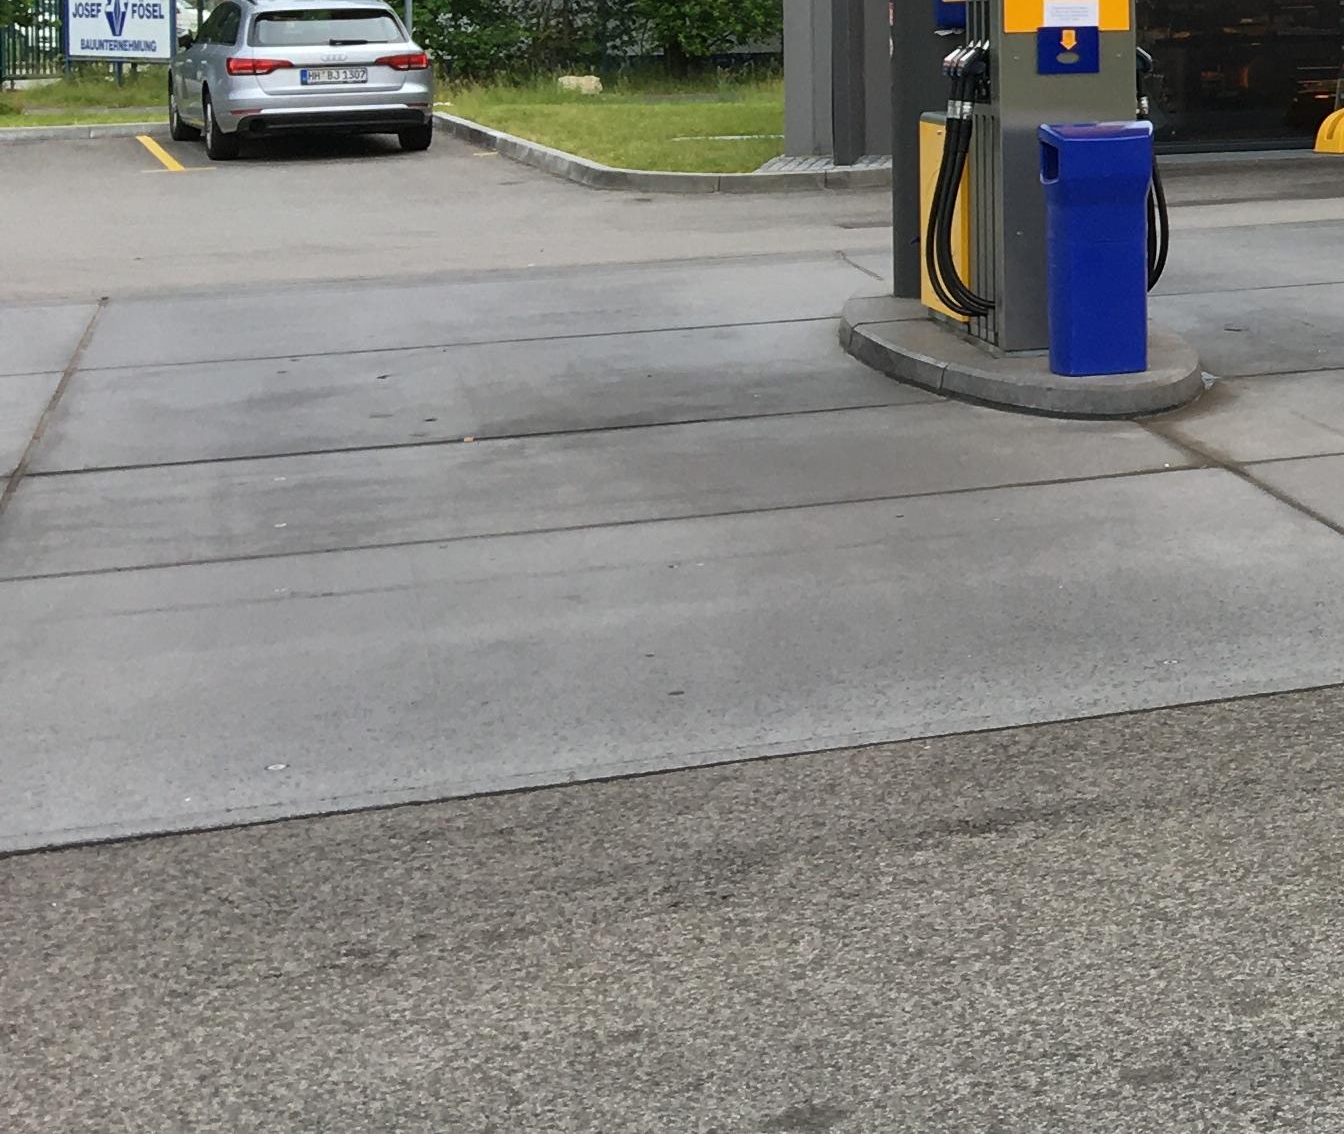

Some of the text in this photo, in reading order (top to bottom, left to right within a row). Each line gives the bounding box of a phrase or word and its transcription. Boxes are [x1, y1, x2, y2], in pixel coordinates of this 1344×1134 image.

[72, 0, 165, 20] JOSEF FÖSEL
[80, 39, 157, 52] BAUUNTERNEHMUNG
